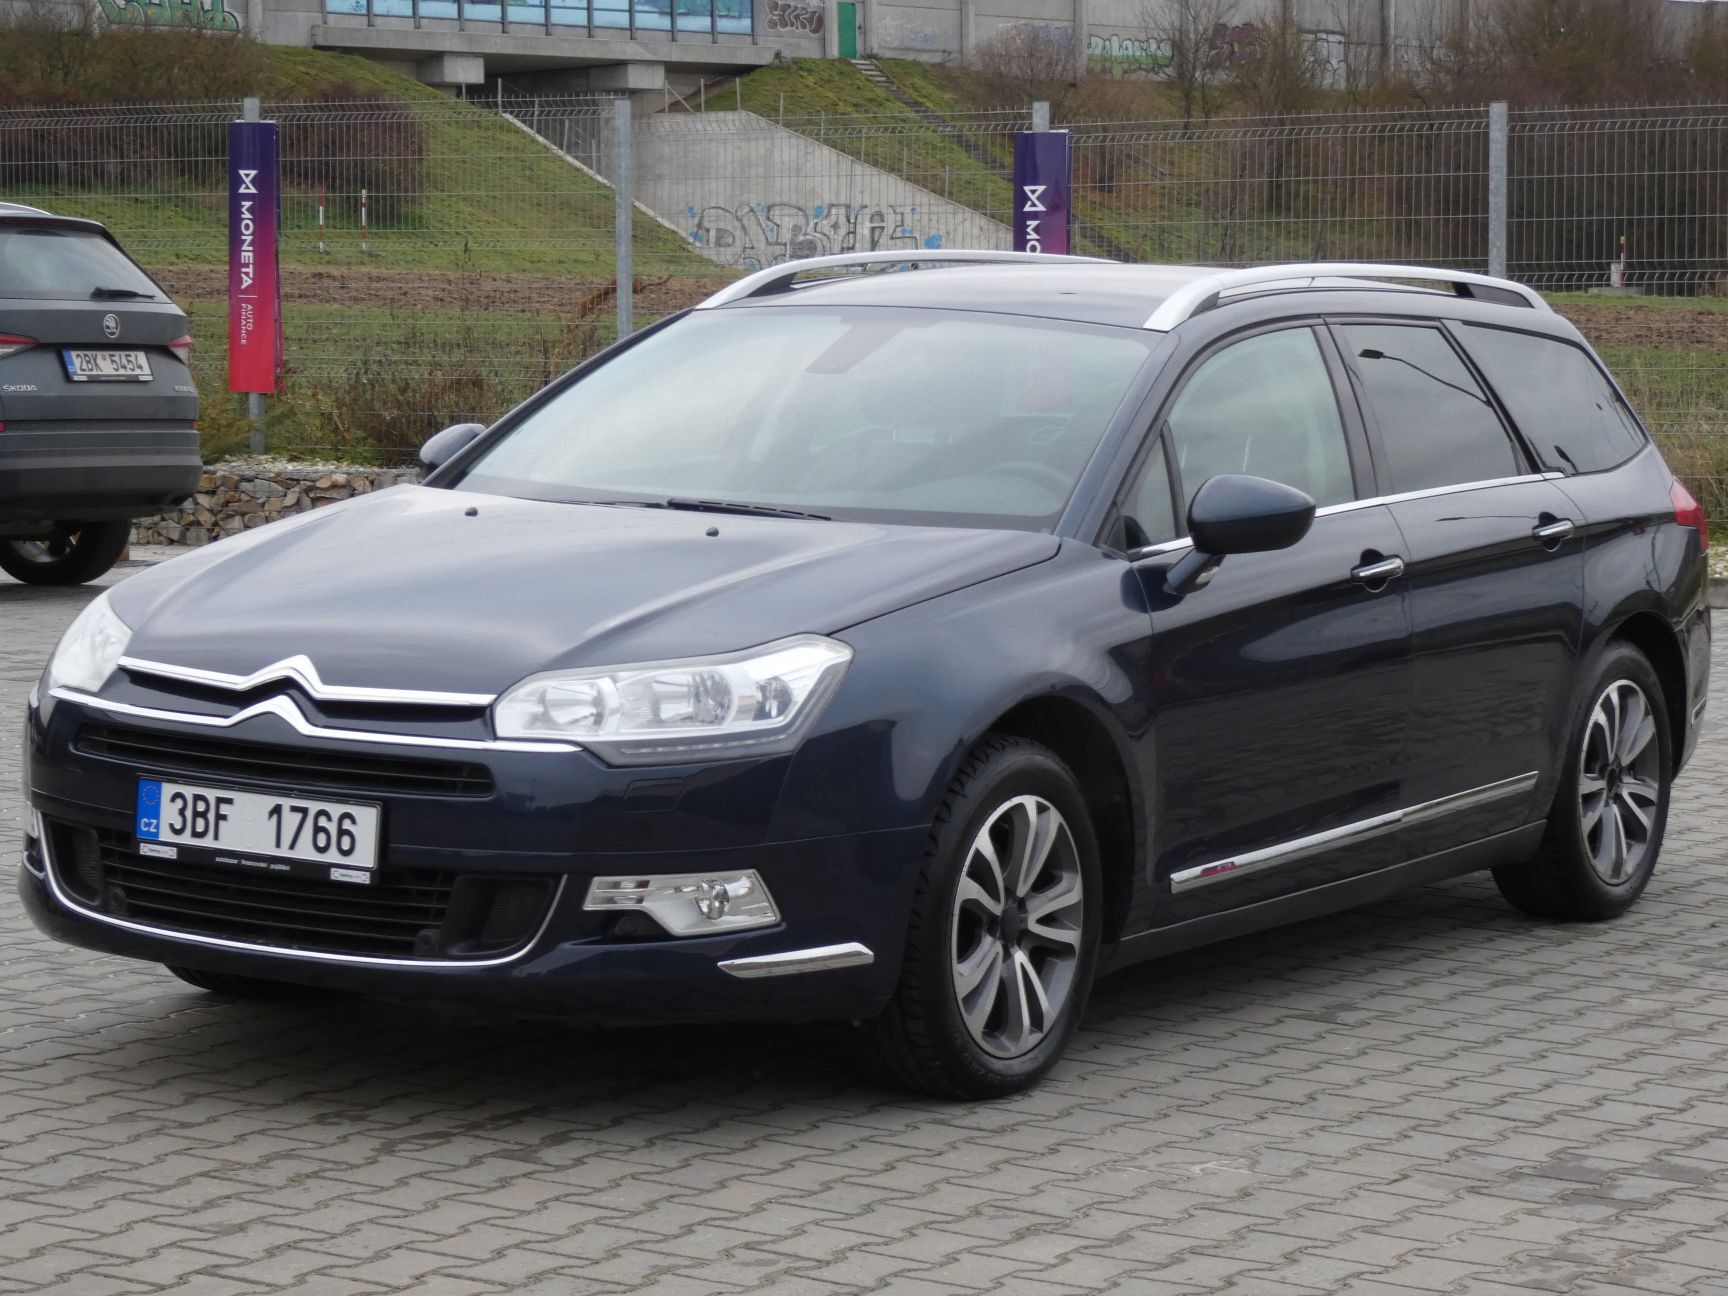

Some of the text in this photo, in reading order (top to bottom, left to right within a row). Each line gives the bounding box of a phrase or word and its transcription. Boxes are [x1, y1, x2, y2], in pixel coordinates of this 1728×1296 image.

[240, 201, 254, 290] MONETA
[246, 303, 254, 330] AUTO
[75, 353, 144, 373] 2BK 5454
[140, 818, 158, 832] CZ
[168, 791, 357, 857] 3BF 1766
